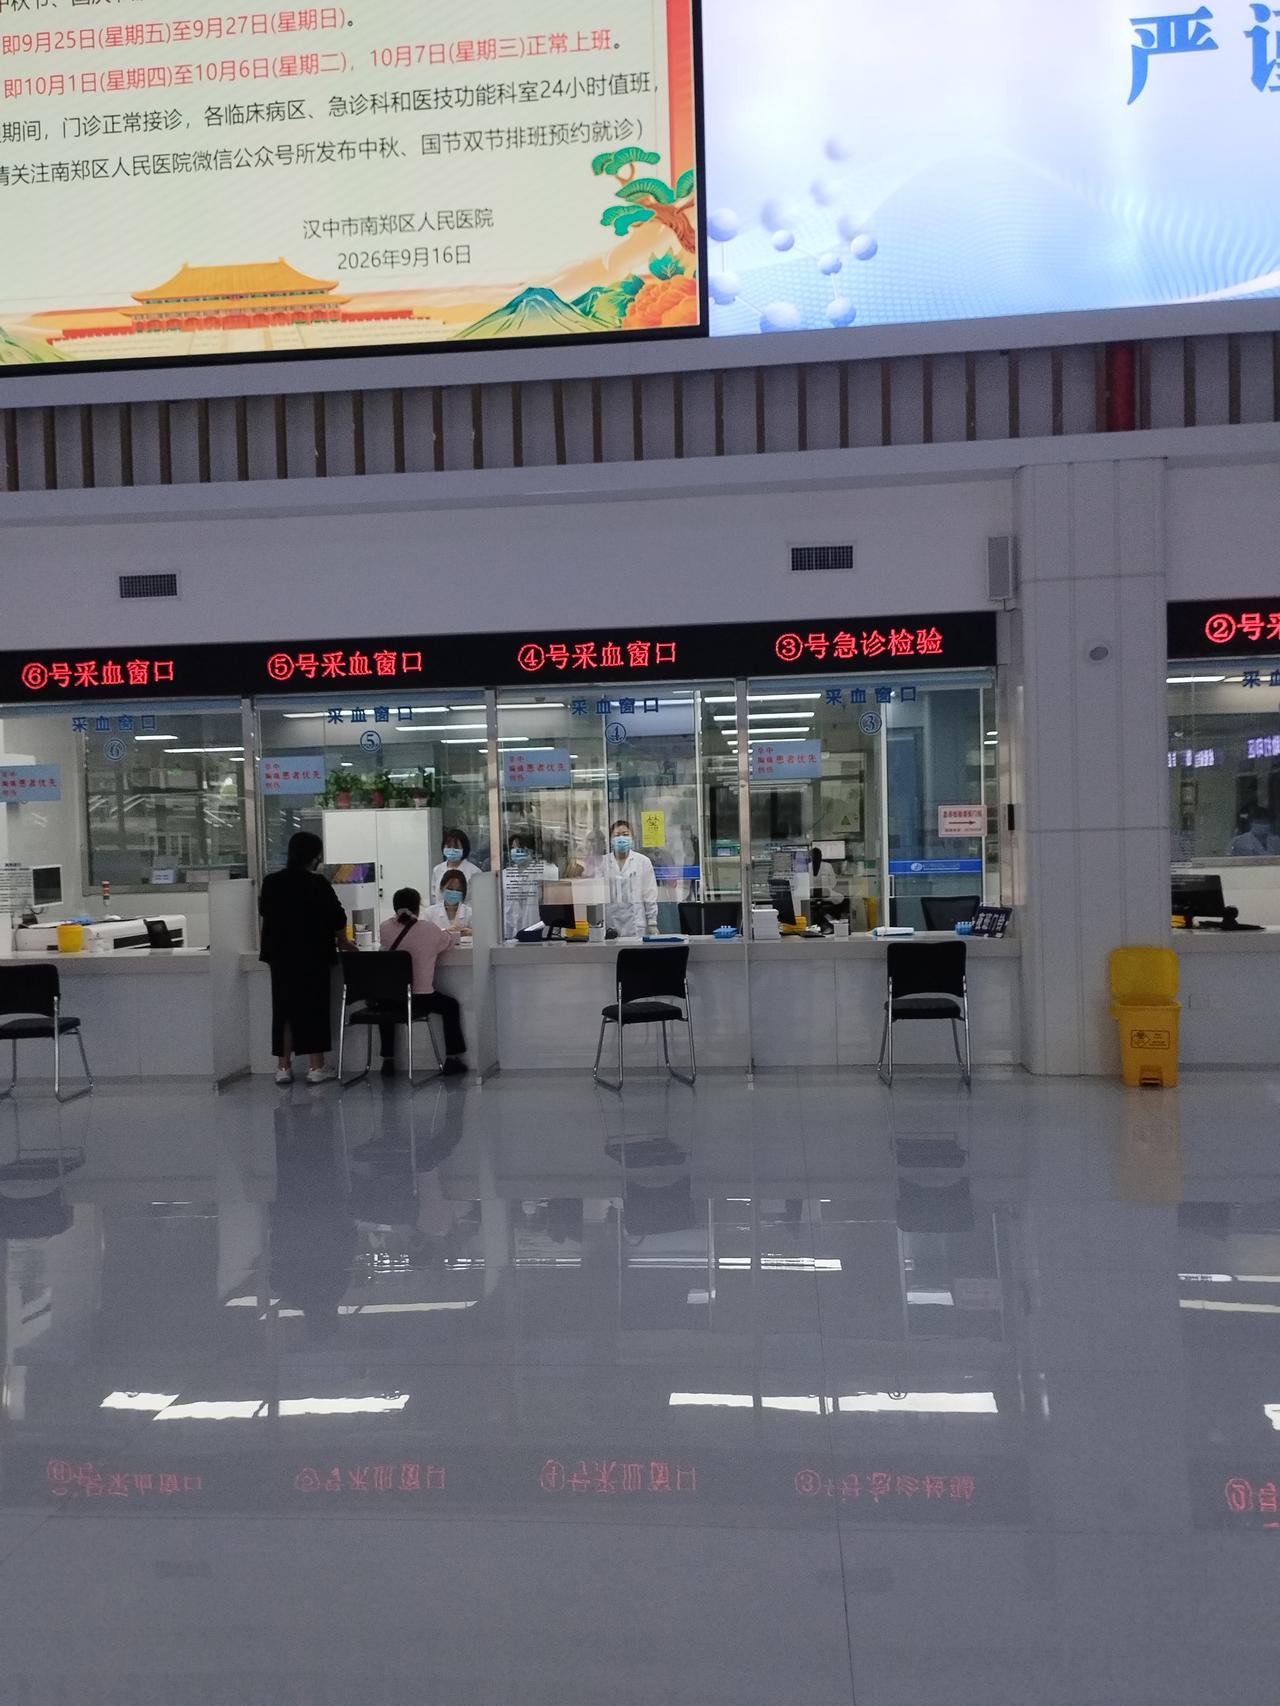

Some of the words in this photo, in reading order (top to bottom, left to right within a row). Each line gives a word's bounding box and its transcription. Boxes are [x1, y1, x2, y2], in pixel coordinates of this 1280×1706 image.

[0, 71, 659, 143] 期间，门诊正常接诊，各临床病区、急诊科和医技功能科室24小时值班，
[303, 208, 495, 240] 汉中市南郑区人民医院
[337, 244, 471, 270] 2026年9月16日
[571, 695, 659, 716] 采血窗口
[825, 686, 917, 706] 采血窗口
[72, 714, 156, 733] 采血窗口
[327, 705, 413, 724] 采血窗口
